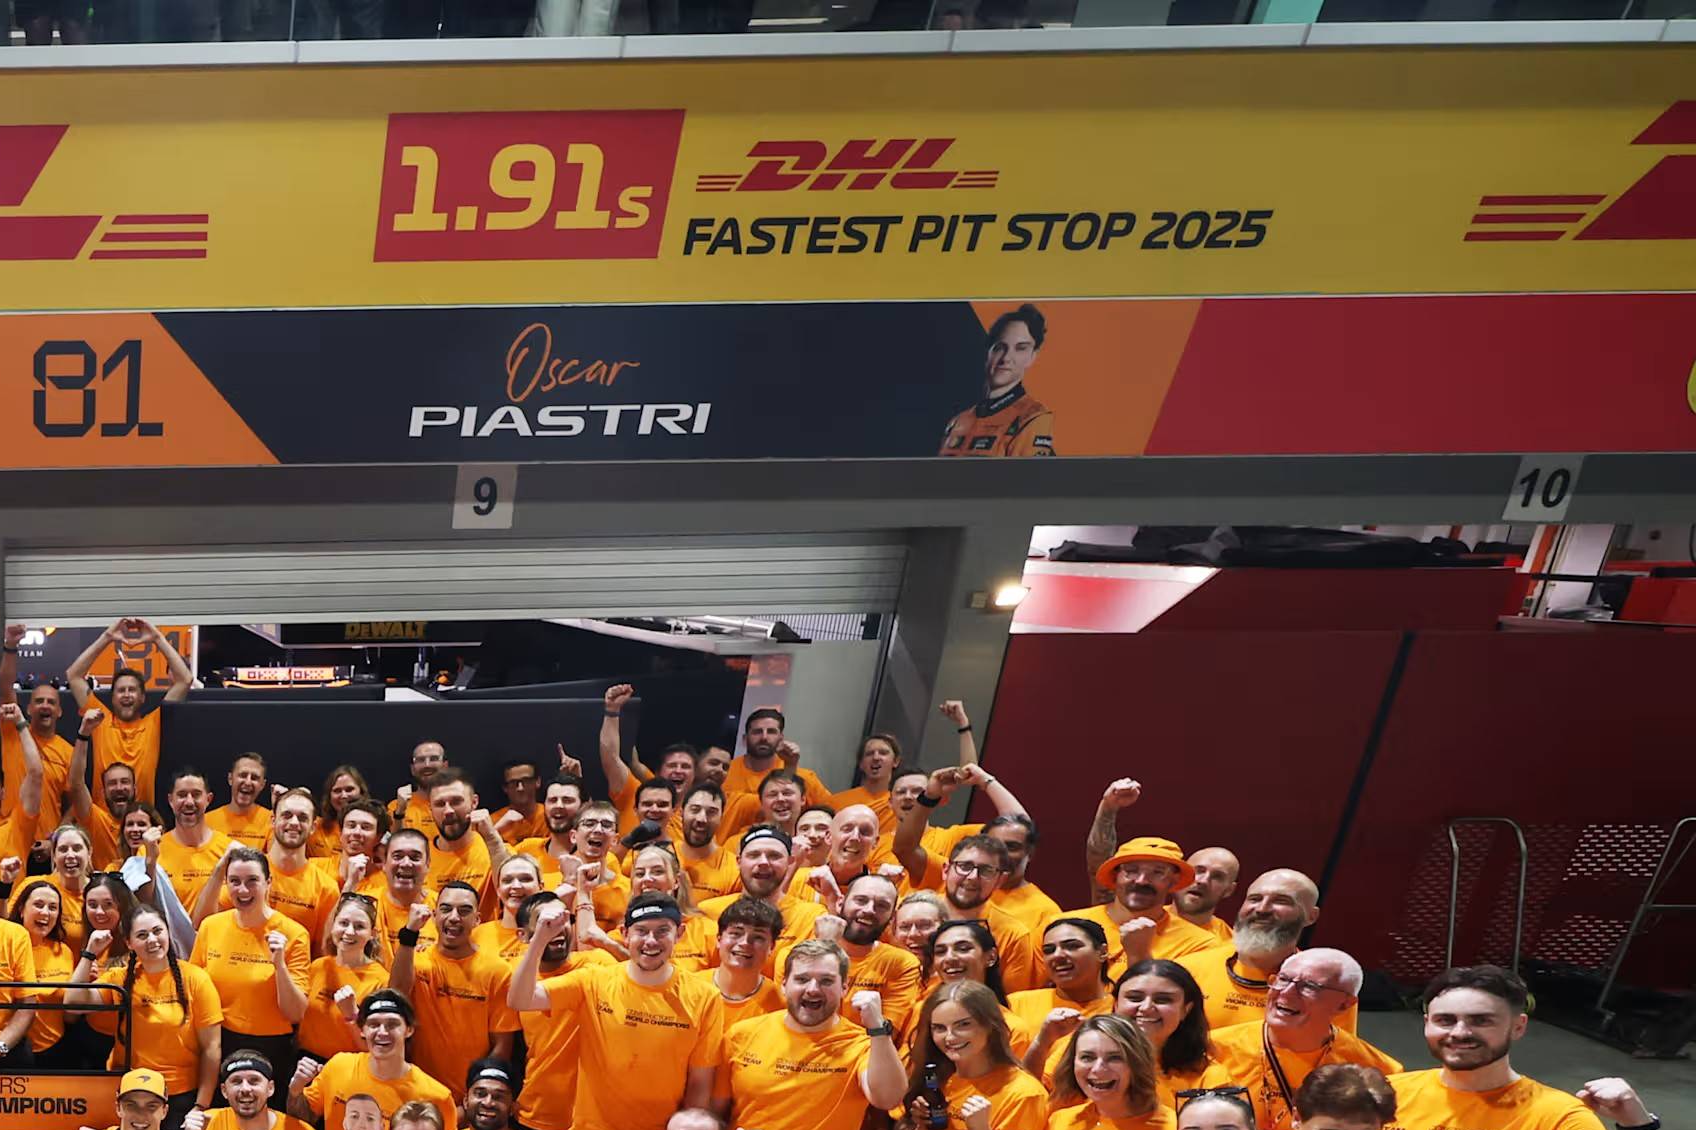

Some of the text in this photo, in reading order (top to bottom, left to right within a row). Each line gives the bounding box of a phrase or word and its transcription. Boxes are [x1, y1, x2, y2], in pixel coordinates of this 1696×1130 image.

[391, 142, 653, 232] 1.91s
[736, 138, 962, 192] DHL
[683, 209, 1274, 256] FASTEST PIT STOP 2025
[505, 323, 640, 401] Oscar
[33, 339, 164, 438] 81
[409, 403, 712, 438] PIASTRI
[473, 477, 498, 516] 9
[1519, 468, 1571, 508] 10
